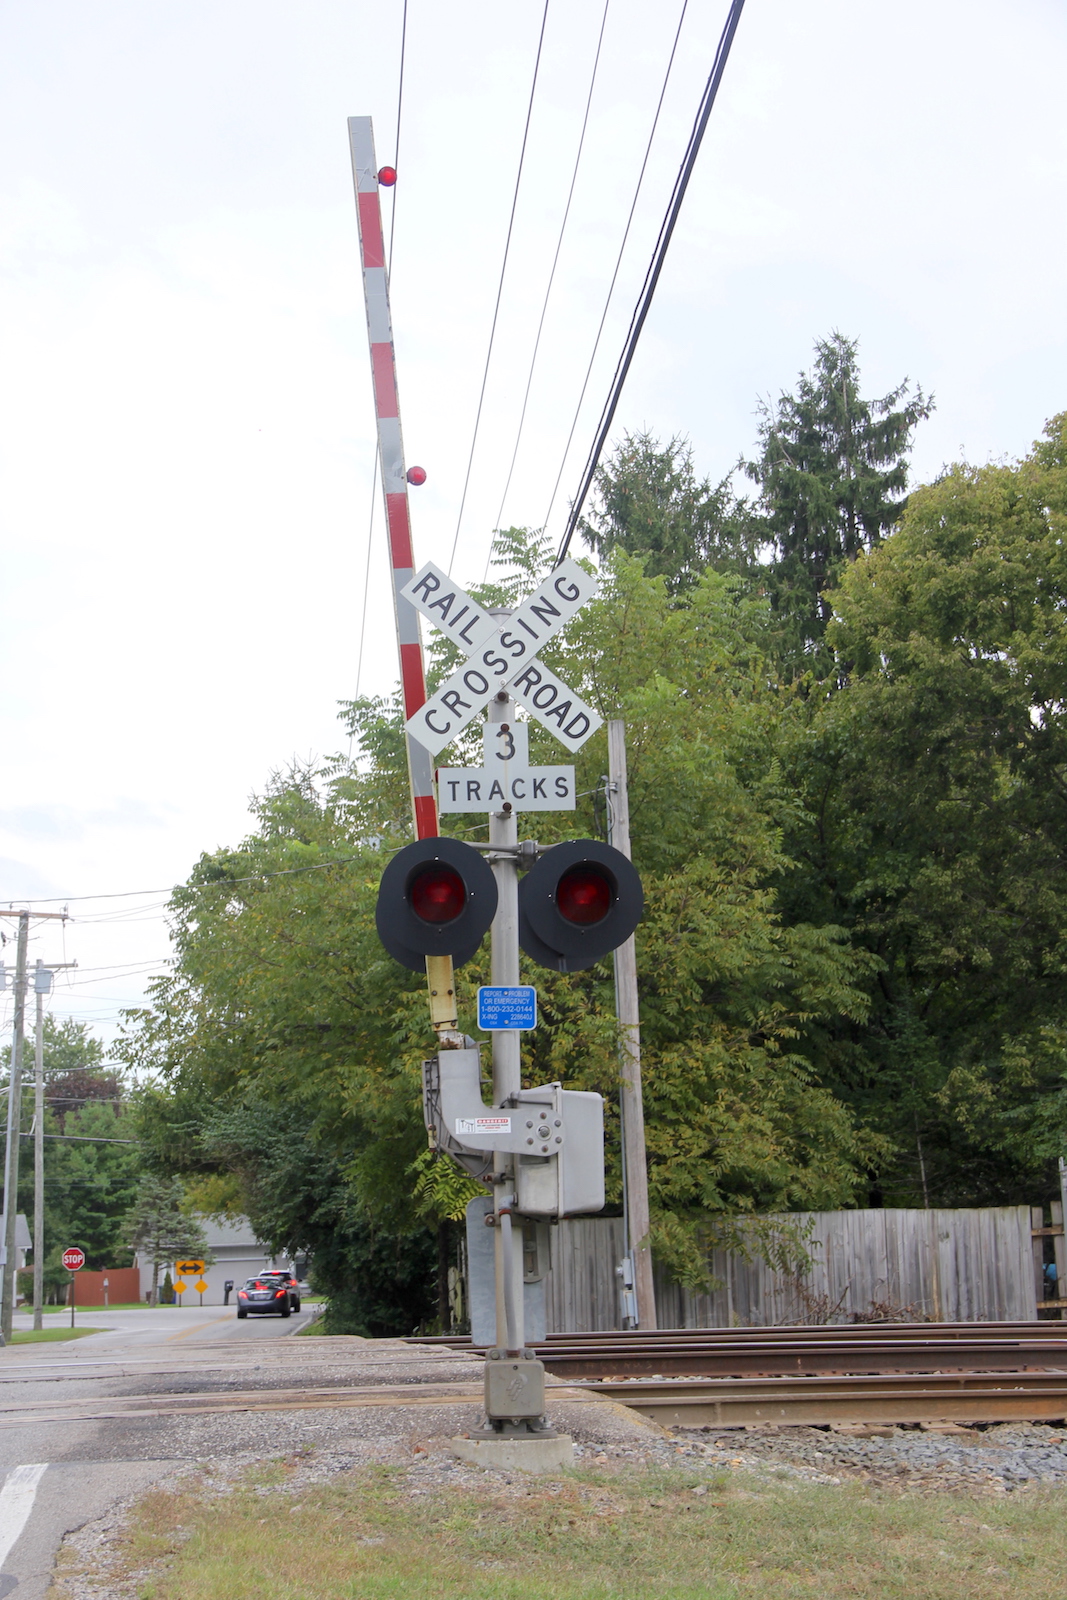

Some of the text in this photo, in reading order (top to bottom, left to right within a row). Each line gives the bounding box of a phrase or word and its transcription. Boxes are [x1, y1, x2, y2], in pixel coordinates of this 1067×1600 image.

[411, 571, 591, 739] RAIL ROAD
[424, 576, 581, 735] CROSSING
[495, 730, 516, 761] 3
[447, 776, 570, 802] TRACKS
[64, 1254, 83, 1264] STOP
